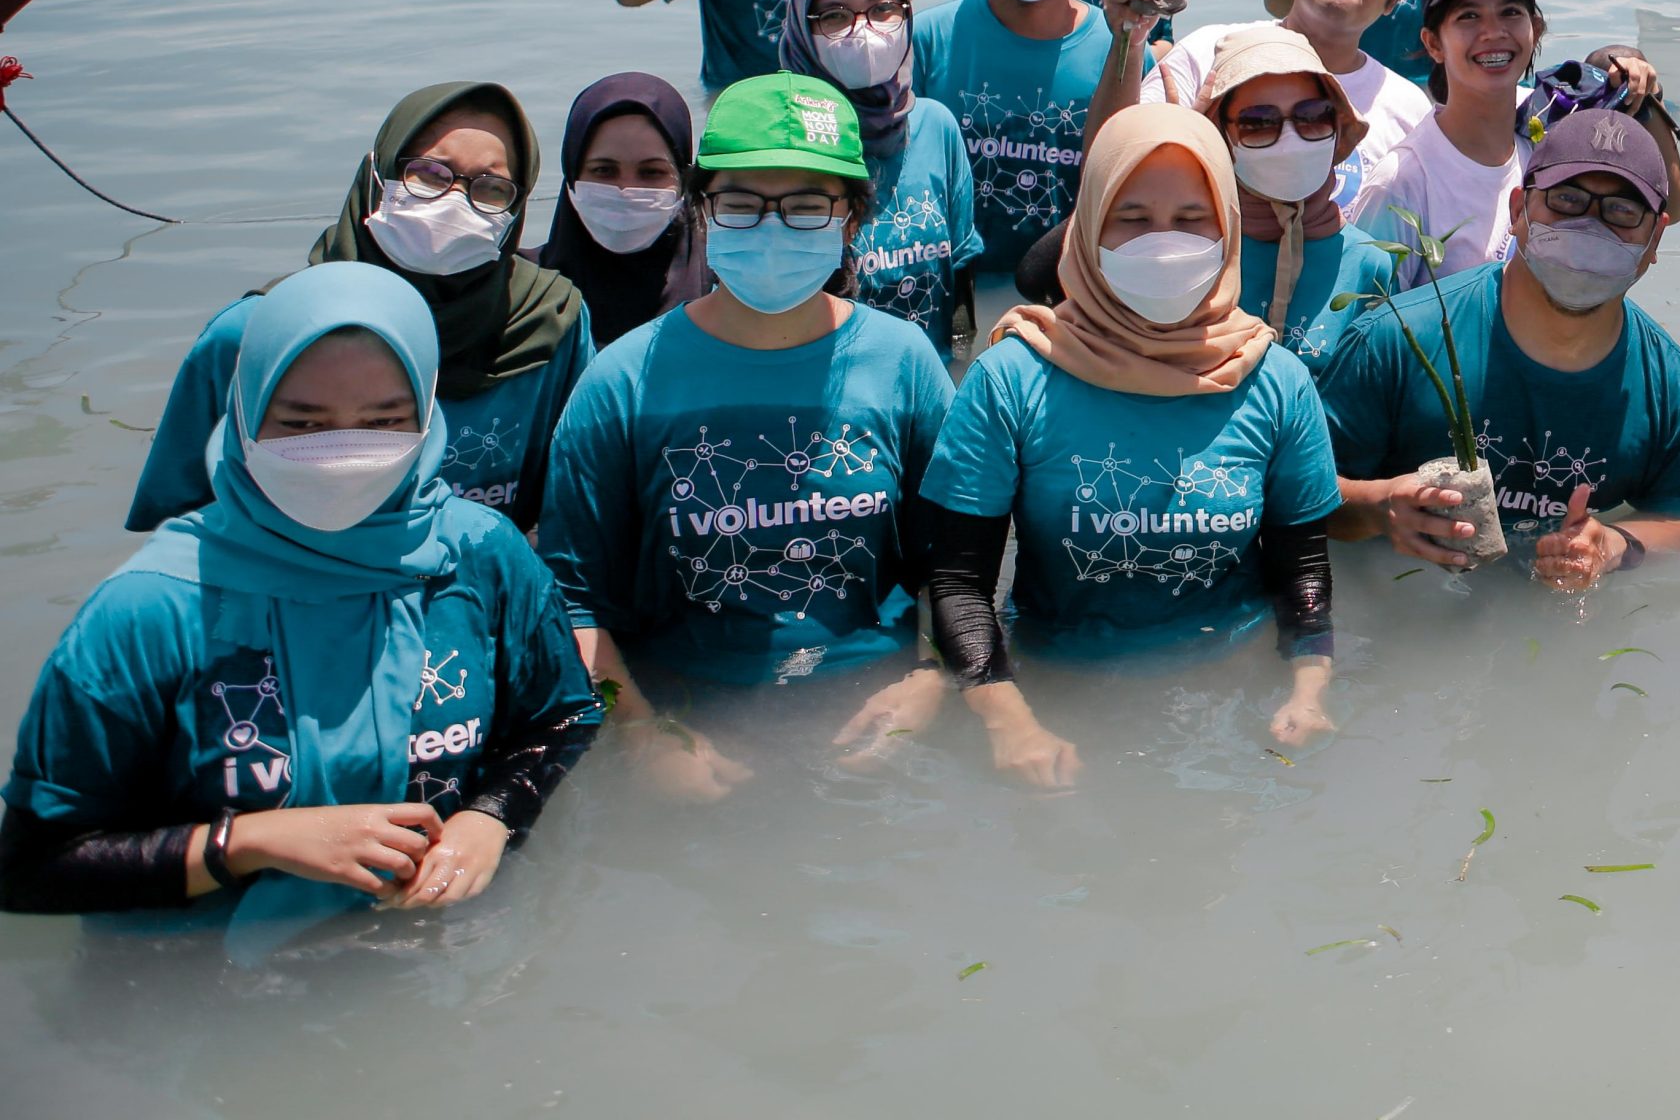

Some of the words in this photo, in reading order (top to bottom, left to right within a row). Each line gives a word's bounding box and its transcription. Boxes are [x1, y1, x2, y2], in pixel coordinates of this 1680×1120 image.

[802, 110, 836, 122] MOVE
[804, 120, 837, 132] NOW
[807, 132, 840, 146] DAY
[668, 507, 681, 537] i
[688, 490, 889, 536] volunteer.
[1071, 505, 1080, 533] i
[1090, 506, 1258, 535] volunteer.
[223, 757, 239, 797] i
